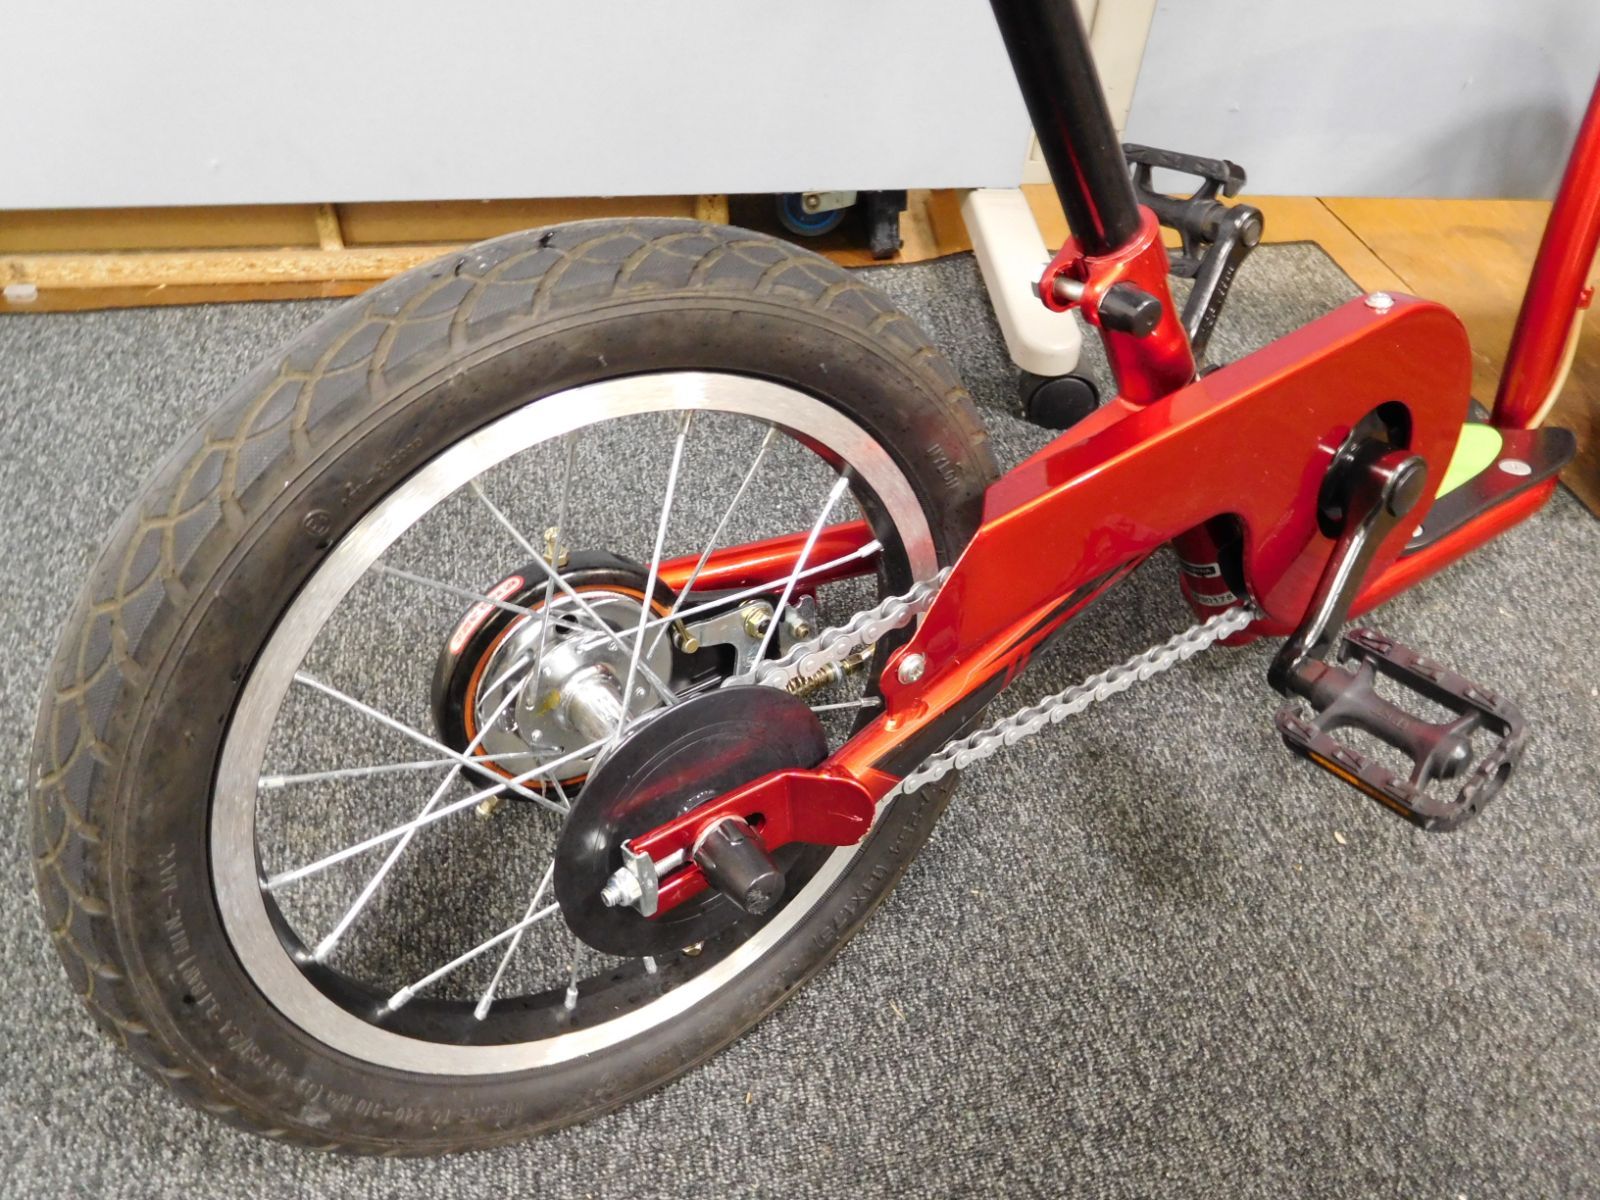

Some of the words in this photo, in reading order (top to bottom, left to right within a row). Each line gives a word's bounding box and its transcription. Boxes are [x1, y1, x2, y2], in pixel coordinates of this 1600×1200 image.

[926, 443, 961, 488] NYLON
[354, 1098, 424, 1123] 240-310
[429, 1107, 452, 1124] TO
